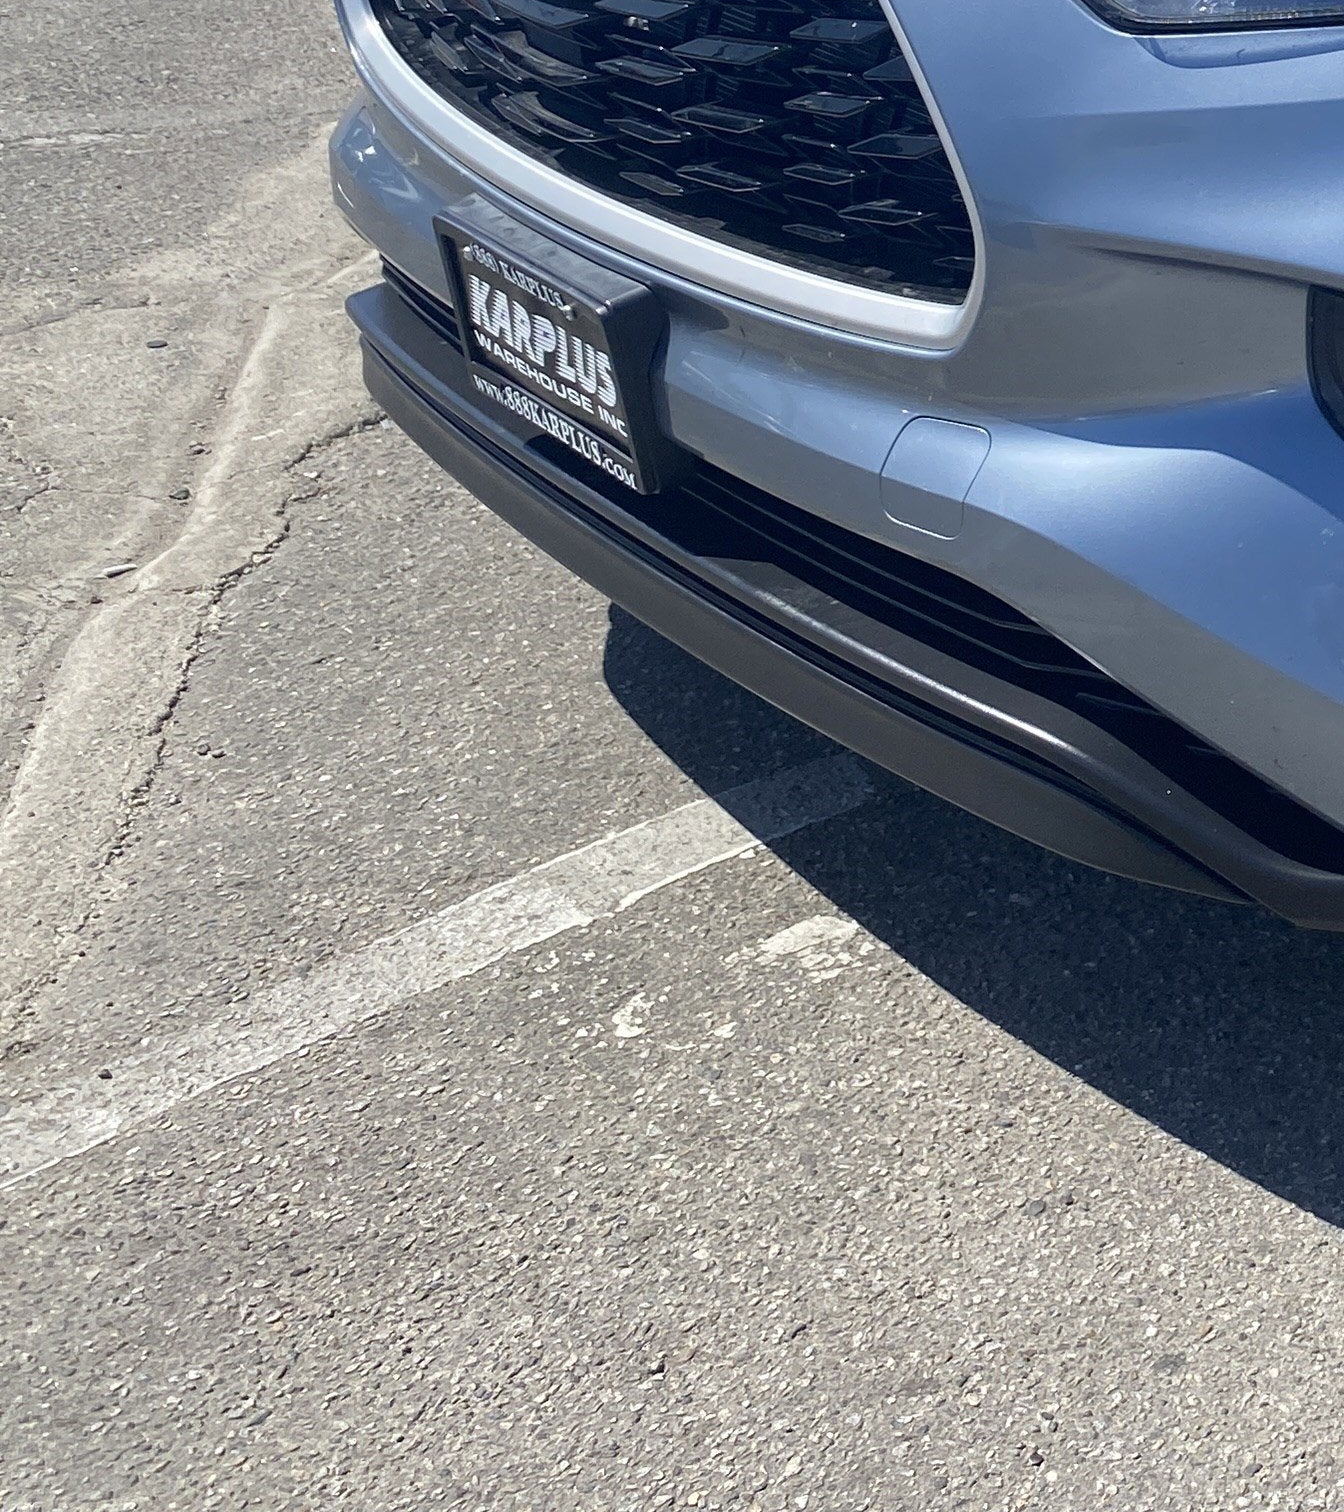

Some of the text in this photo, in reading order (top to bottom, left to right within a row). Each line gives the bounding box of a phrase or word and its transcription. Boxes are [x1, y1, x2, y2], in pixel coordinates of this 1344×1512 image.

[498, 260, 566, 310] KARPLUS
[468, 274, 617, 407] KARPLUS
[474, 329, 628, 438] WAREHOUSE INC
